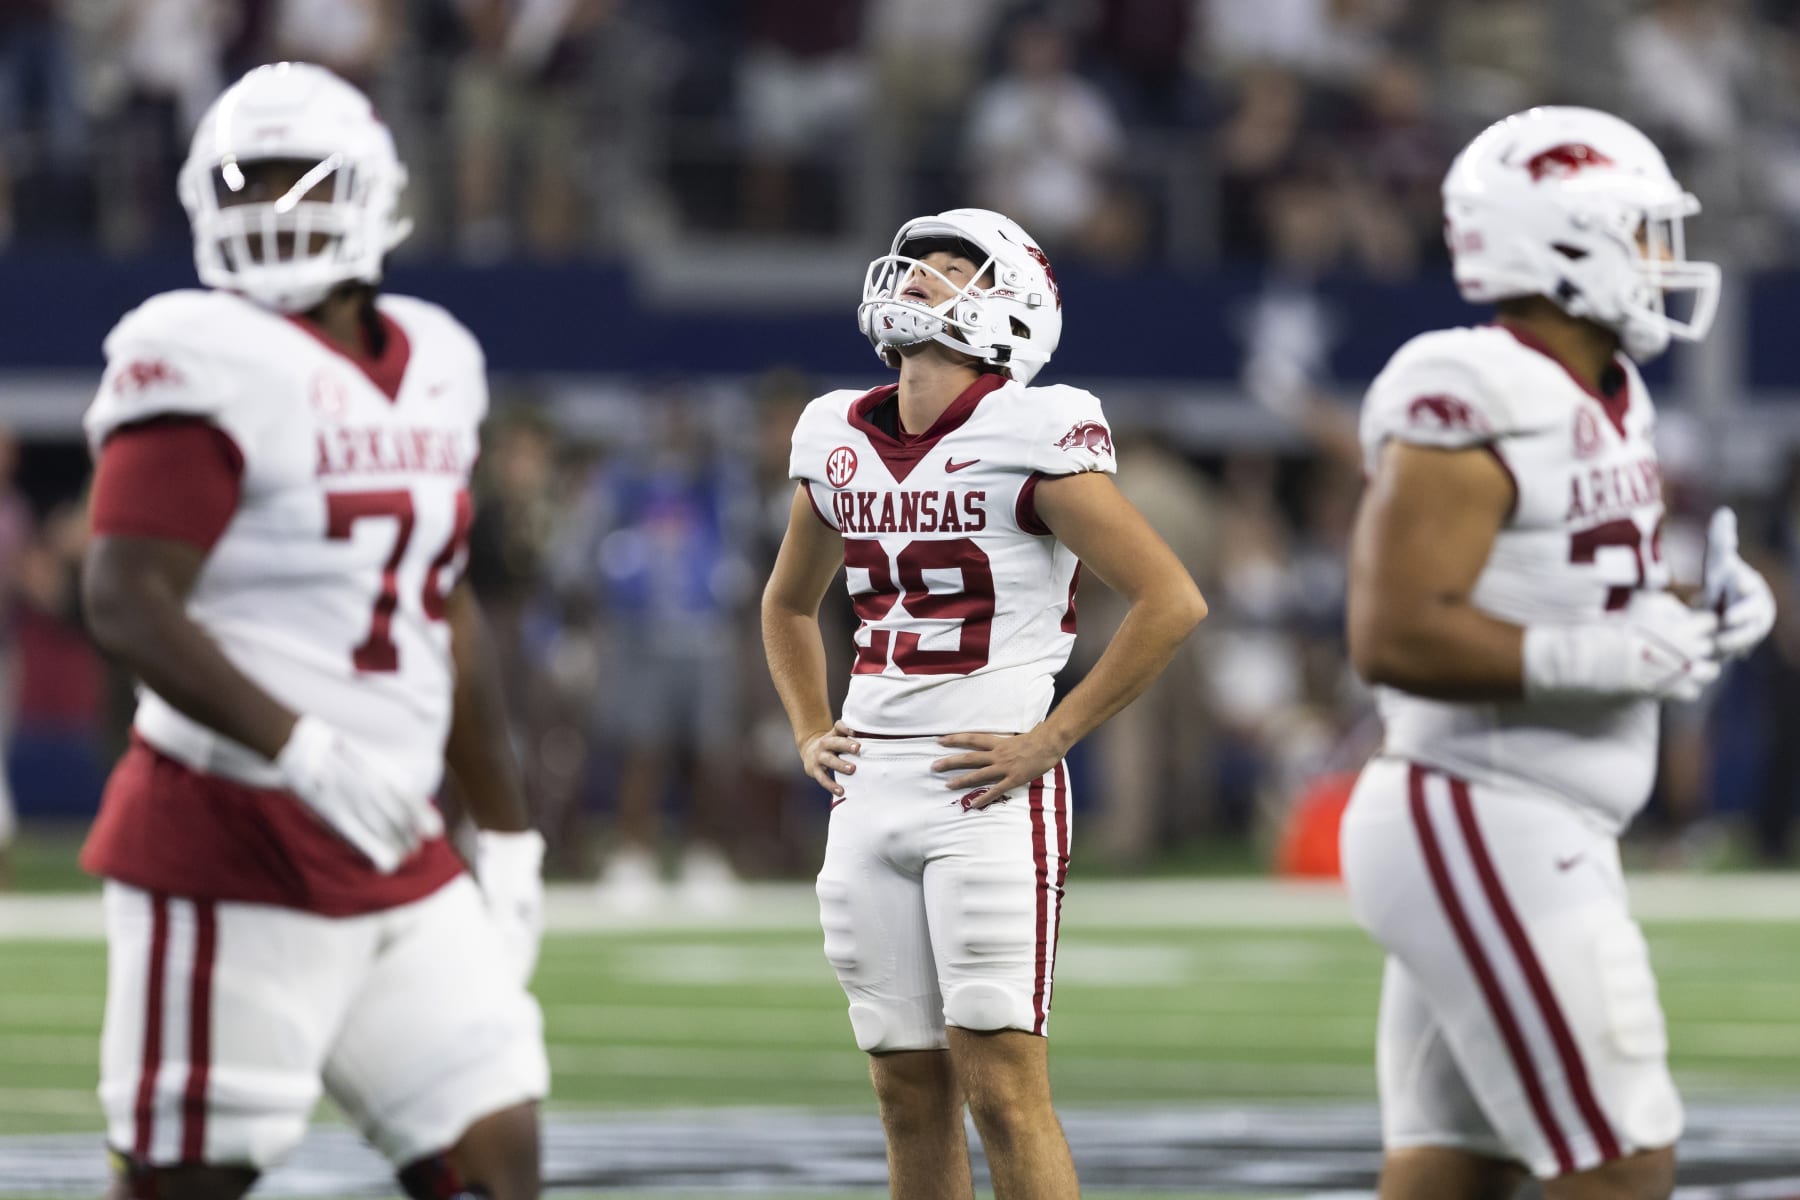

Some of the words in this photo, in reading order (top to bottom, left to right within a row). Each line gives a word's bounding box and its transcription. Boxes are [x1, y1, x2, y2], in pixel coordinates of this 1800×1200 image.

[827, 448, 857, 487] SEC
[833, 491, 986, 533] ARKANSAS
[844, 539, 996, 676] 29
